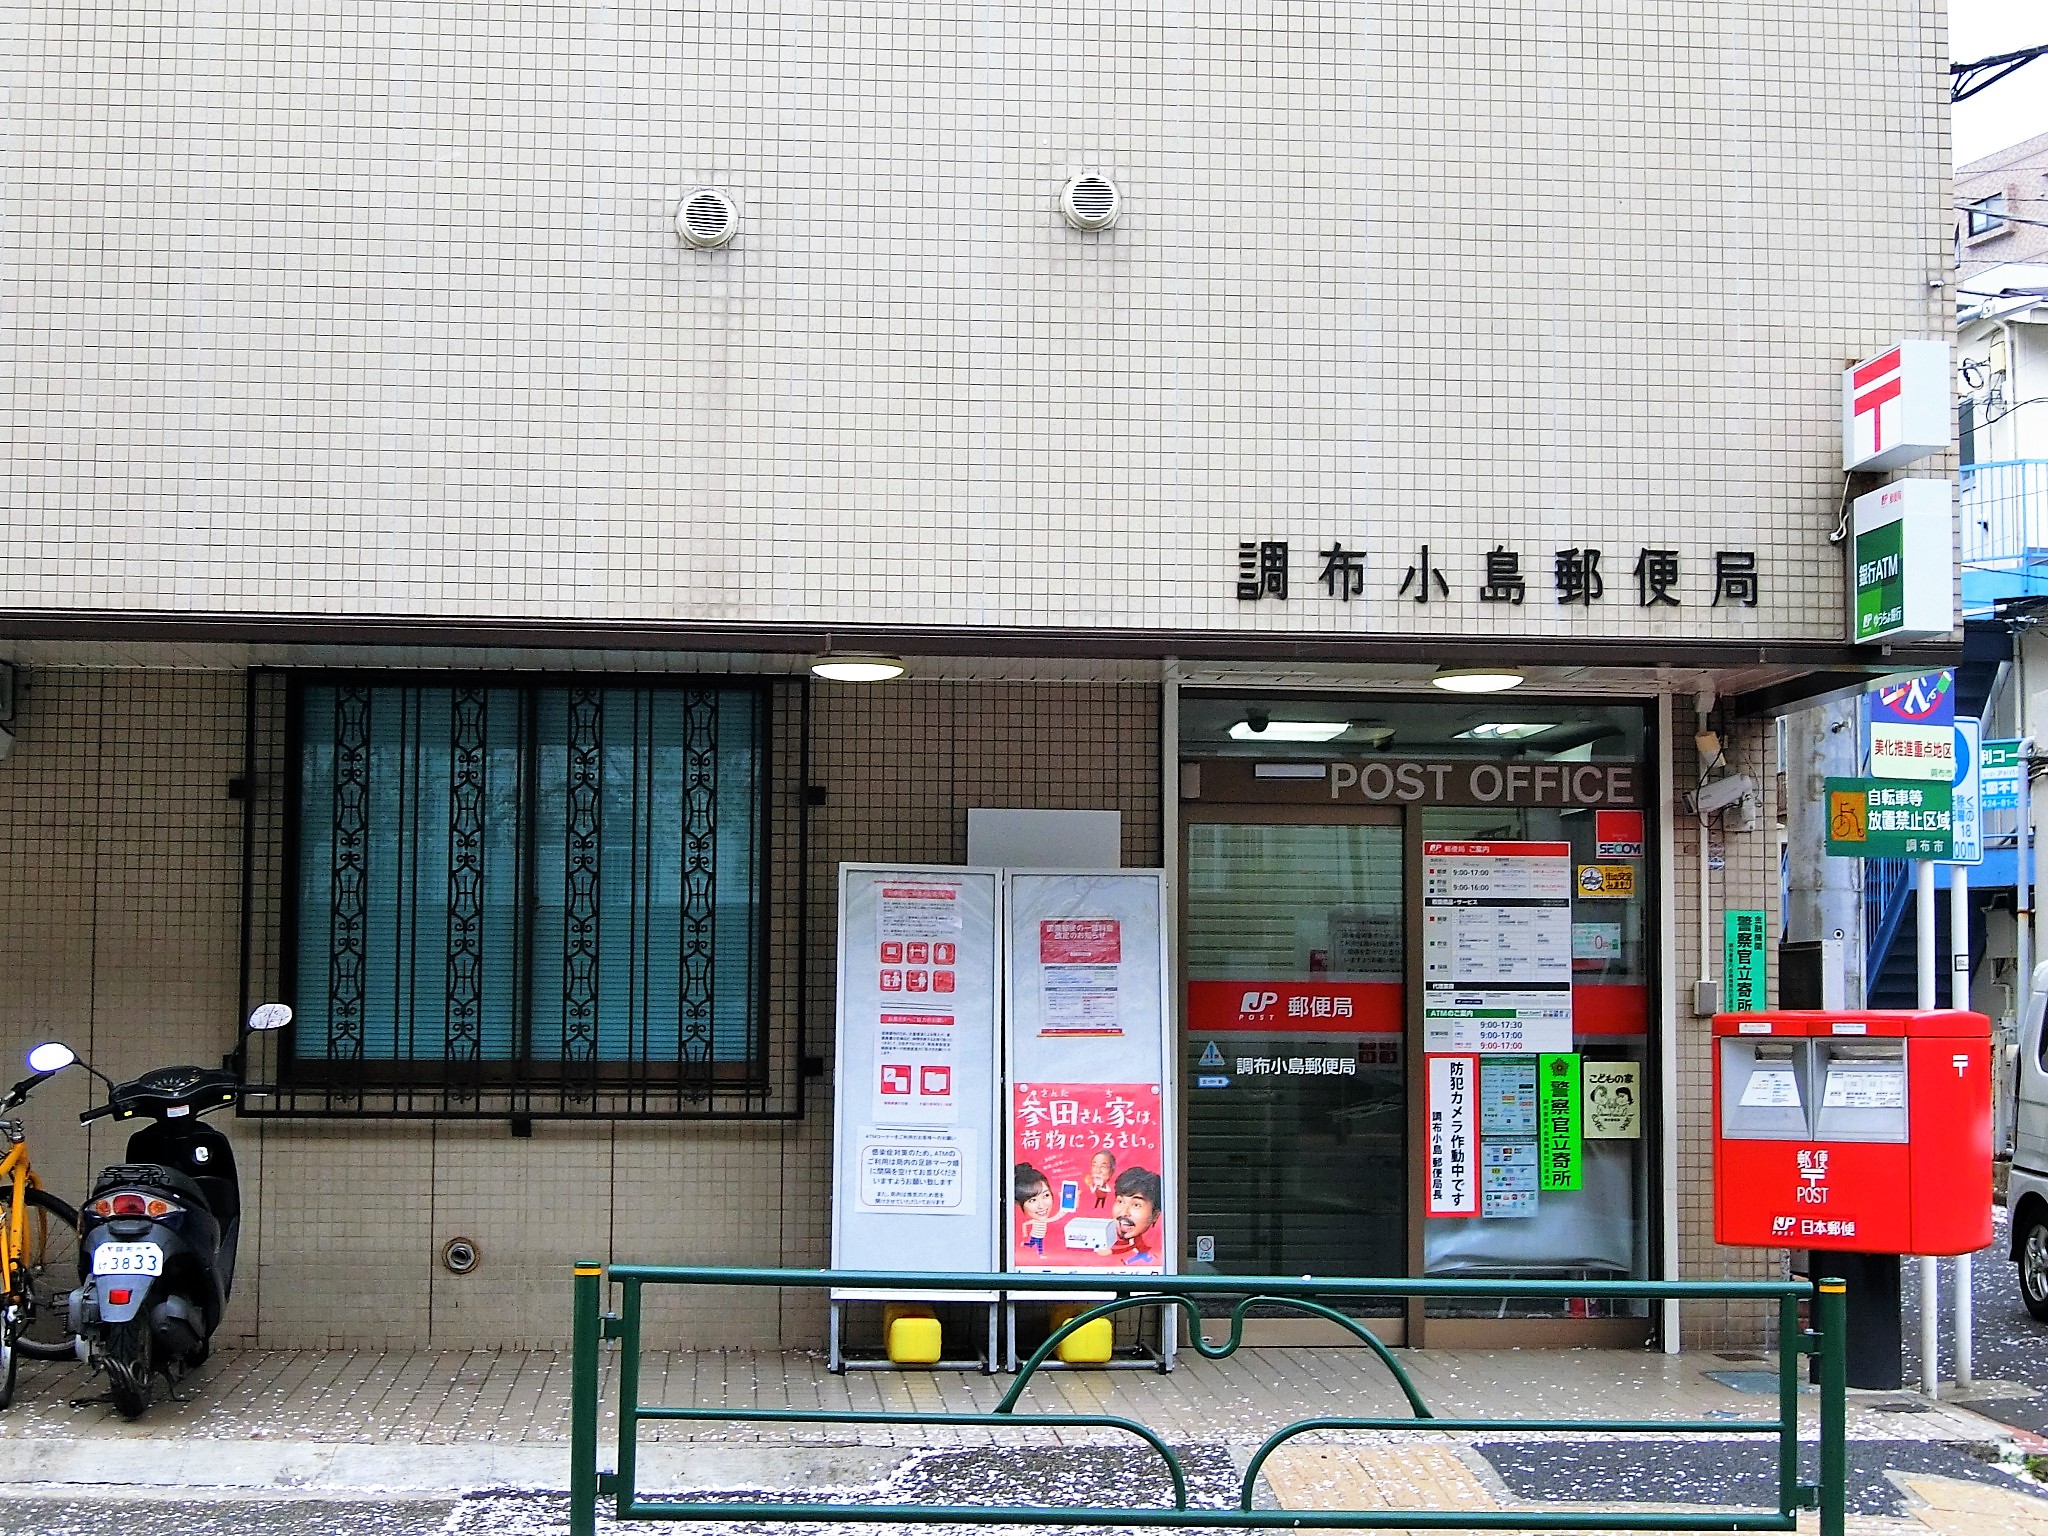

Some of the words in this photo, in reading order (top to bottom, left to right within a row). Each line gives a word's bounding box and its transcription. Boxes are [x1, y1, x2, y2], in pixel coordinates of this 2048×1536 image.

[1236, 541, 1759, 607] 調布小島郵便局
[1858, 553, 1899, 588] 銀行ATM
[1873, 605, 1902, 628] ゆうちょ銀行
[1874, 739, 1953, 760] 美化推進重点地区
[1330, 762, 1453, 801] POST
[1469, 764, 1635, 804] OFFICE
[1867, 788, 1924, 808] 自転車等
[1867, 810, 1952, 831] 放置禁止区域
[1960, 824, 1972, 838] 18
[1599, 843, 1641, 855] SECOM
[1905, 838, 1945, 853] 調布市
[1452, 869, 1489, 877] 9:00-17:00
[1452, 884, 1490, 892] 9:00-16:00
[1736, 915, 1753, 1012] 警察官立寄所
[1287, 996, 1354, 1018] 郵便局
[1430, 1009, 1474, 1018] ATMのご案内
[1480, 1021, 1523, 1029] 9:00-17:30
[1480, 1031, 1523, 1039] 9:00-17:00
[1480, 1041, 1523, 1050] 9:00-17:00
[1235, 1056, 1357, 1076] 調布小島郵便局
[1588, 1073, 1635, 1084] こどもの家
[1040, 1087, 1070, 1099] さんた
[1105, 1088, 1114, 1099] ち
[1018, 1090, 1158, 1129] 参田さん家は、
[1020, 1129, 1155, 1151] 荷物にうるさい。
[1449, 1061, 1466, 1207] 防犯カメラ作動中です
[1550, 1080, 1572, 1187] 警察官立寄所
[871, 1148, 956, 1158] 感染症対策のため、ATMの
[1431, 1111, 1443, 1200] 調布小島郵便局長
[1796, 1149, 1829, 1170] 郵便
[1796, 1186, 1829, 1204] POST
[1801, 1219, 1856, 1237] 日本郵便
[110, 1254, 158, 1271] 3833
